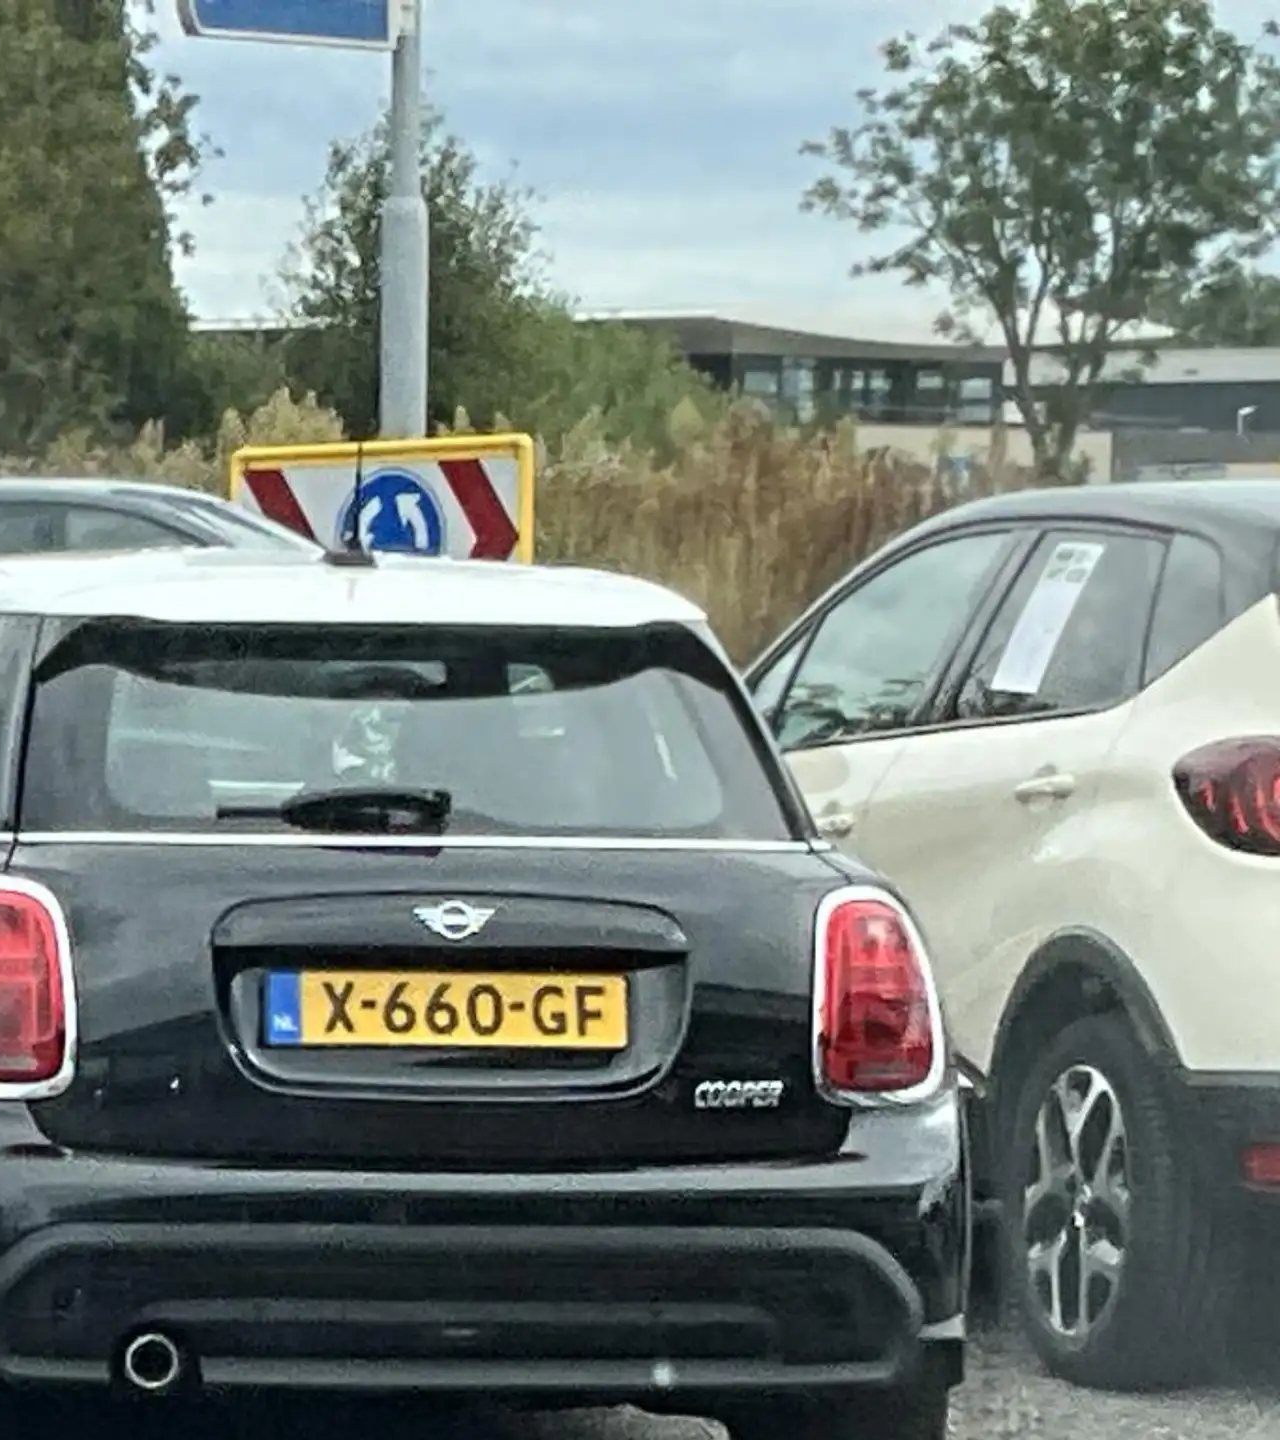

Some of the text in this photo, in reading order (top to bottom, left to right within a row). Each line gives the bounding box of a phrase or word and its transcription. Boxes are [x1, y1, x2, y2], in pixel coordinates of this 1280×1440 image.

[273, 980, 606, 1037] NL X-660-GF
[694, 1080, 784, 1108] COOPER
